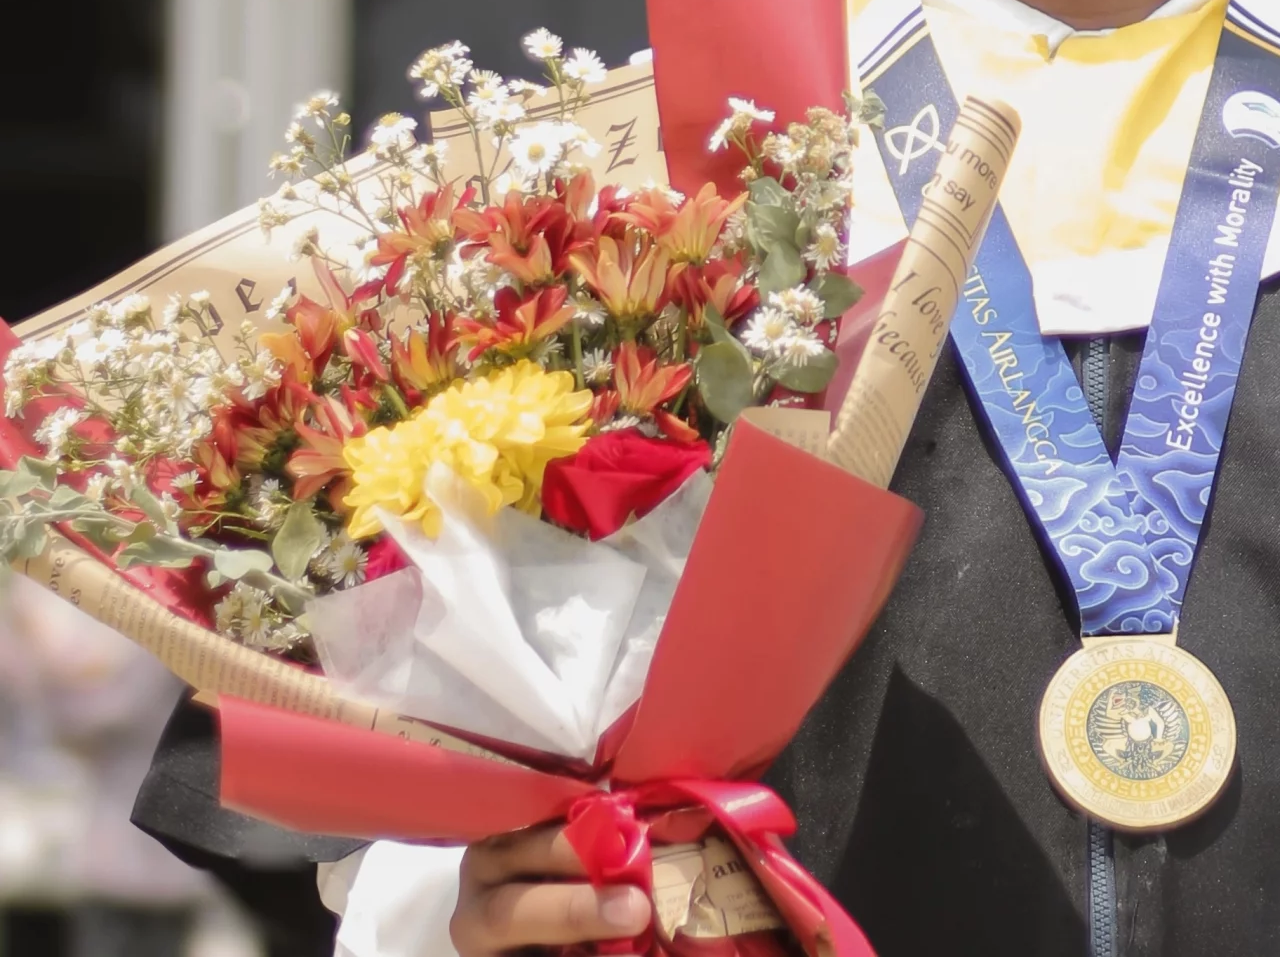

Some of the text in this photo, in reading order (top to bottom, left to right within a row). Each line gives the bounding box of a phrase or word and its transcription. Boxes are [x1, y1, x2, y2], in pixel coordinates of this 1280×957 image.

[960, 148, 998, 190] more
[943, 180, 977, 212] say
[911, 286, 945, 335] love
[1165, 157, 1265, 451] Excellence with Morality
[981, 331, 1063, 476] AIRLANGGA
